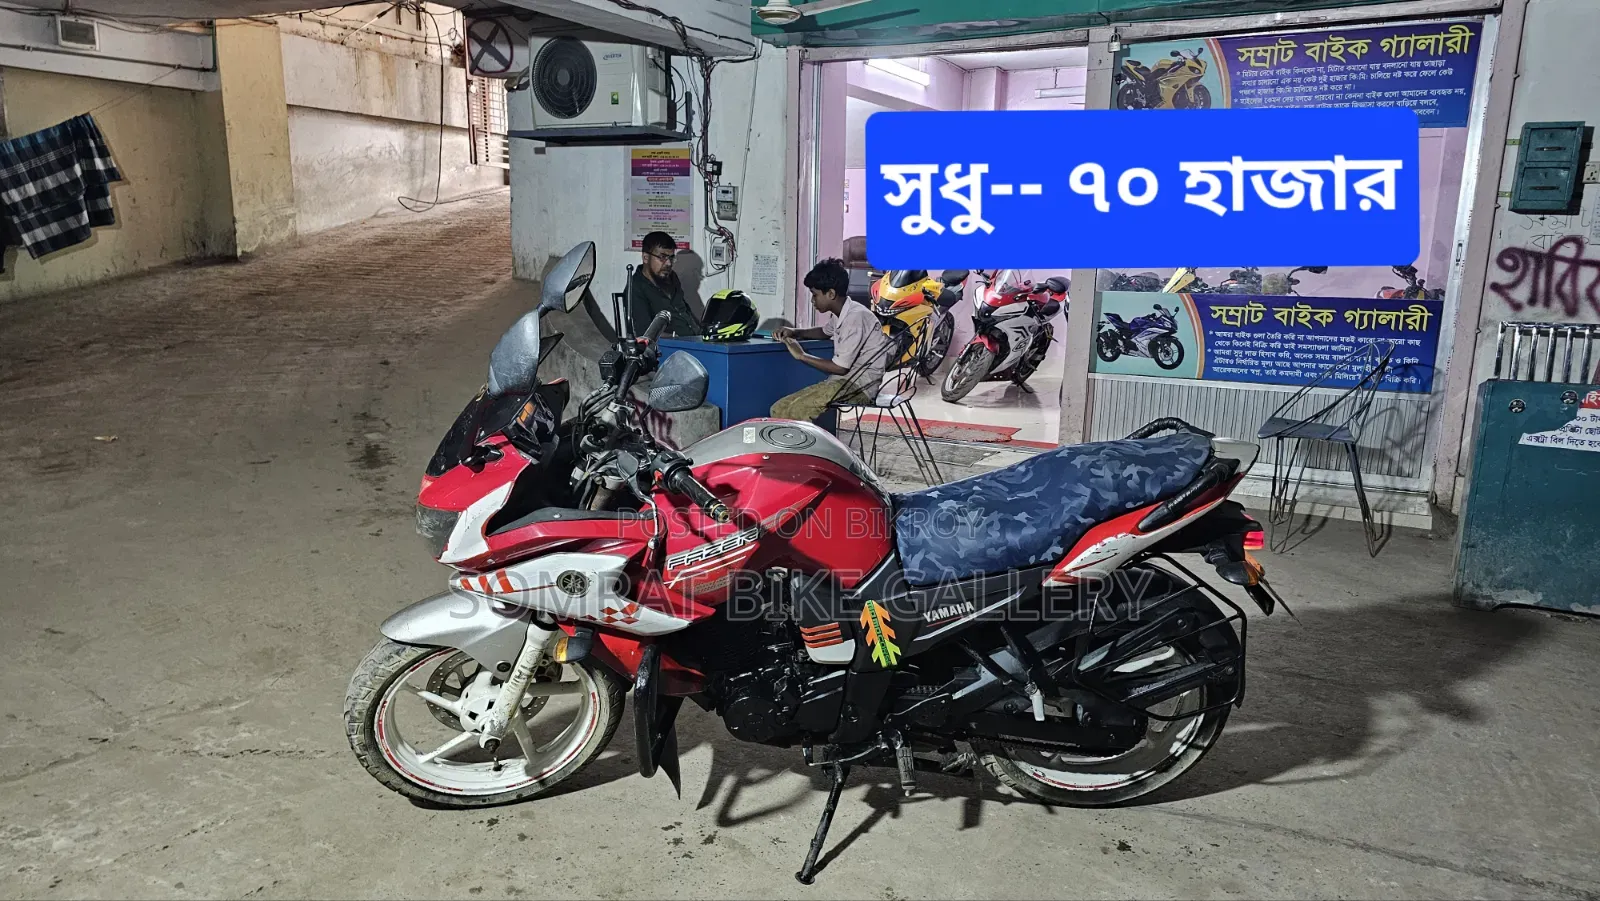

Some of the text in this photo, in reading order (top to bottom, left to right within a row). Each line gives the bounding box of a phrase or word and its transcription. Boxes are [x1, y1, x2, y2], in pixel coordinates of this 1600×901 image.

[1236, 25, 1475, 68] সম্রাট বাইক গ্যালারী
[1276, 67, 1291, 76] বাইক
[1365, 91, 1382, 99] বাইক
[1209, 300, 1433, 332] সম্রাট বাইক গ্যালারী
[1235, 330, 1251, 339] বাইক
[1284, 332, 1296, 340] করি
[1283, 342, 1296, 350] তাই
[1265, 368, 1277, 376] তাই
[666, 527, 759, 571] FAZER
[922, 601, 975, 623] YAMAHA
